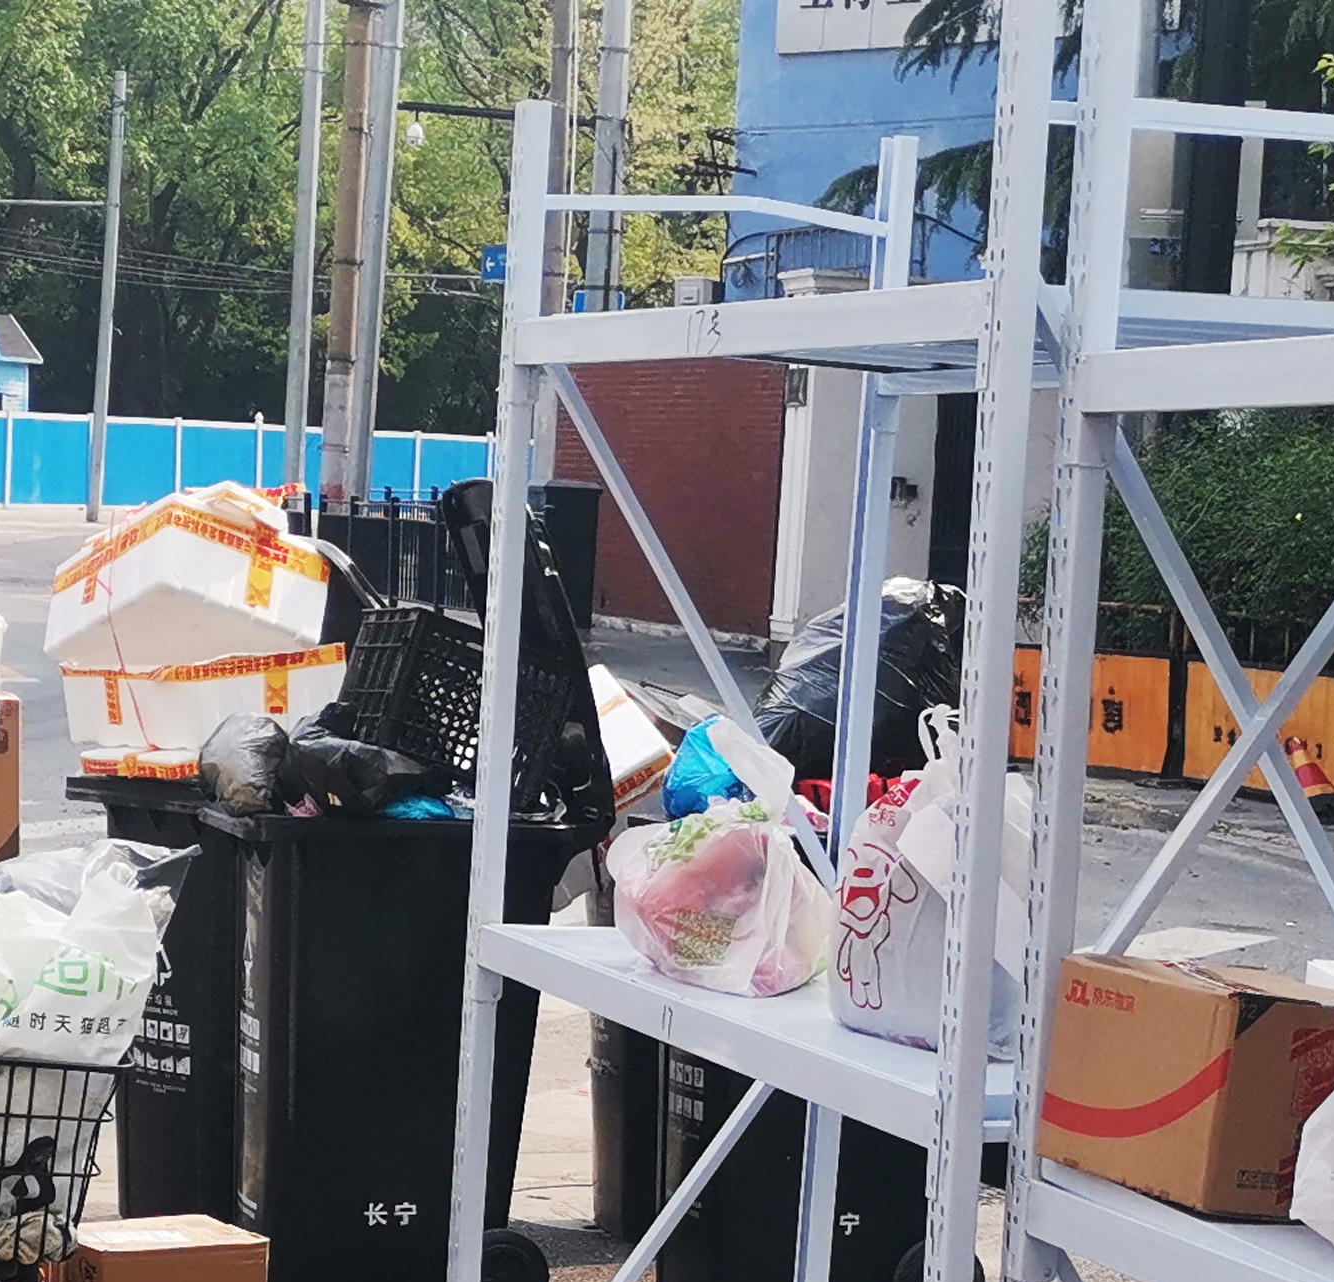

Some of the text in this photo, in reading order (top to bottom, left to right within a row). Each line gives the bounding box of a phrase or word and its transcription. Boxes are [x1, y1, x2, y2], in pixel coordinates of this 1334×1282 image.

[1065, 979, 1090, 1008] JDL
[363, 1201, 418, 1227] 长宁
[839, 1211, 861, 1236] 宁
